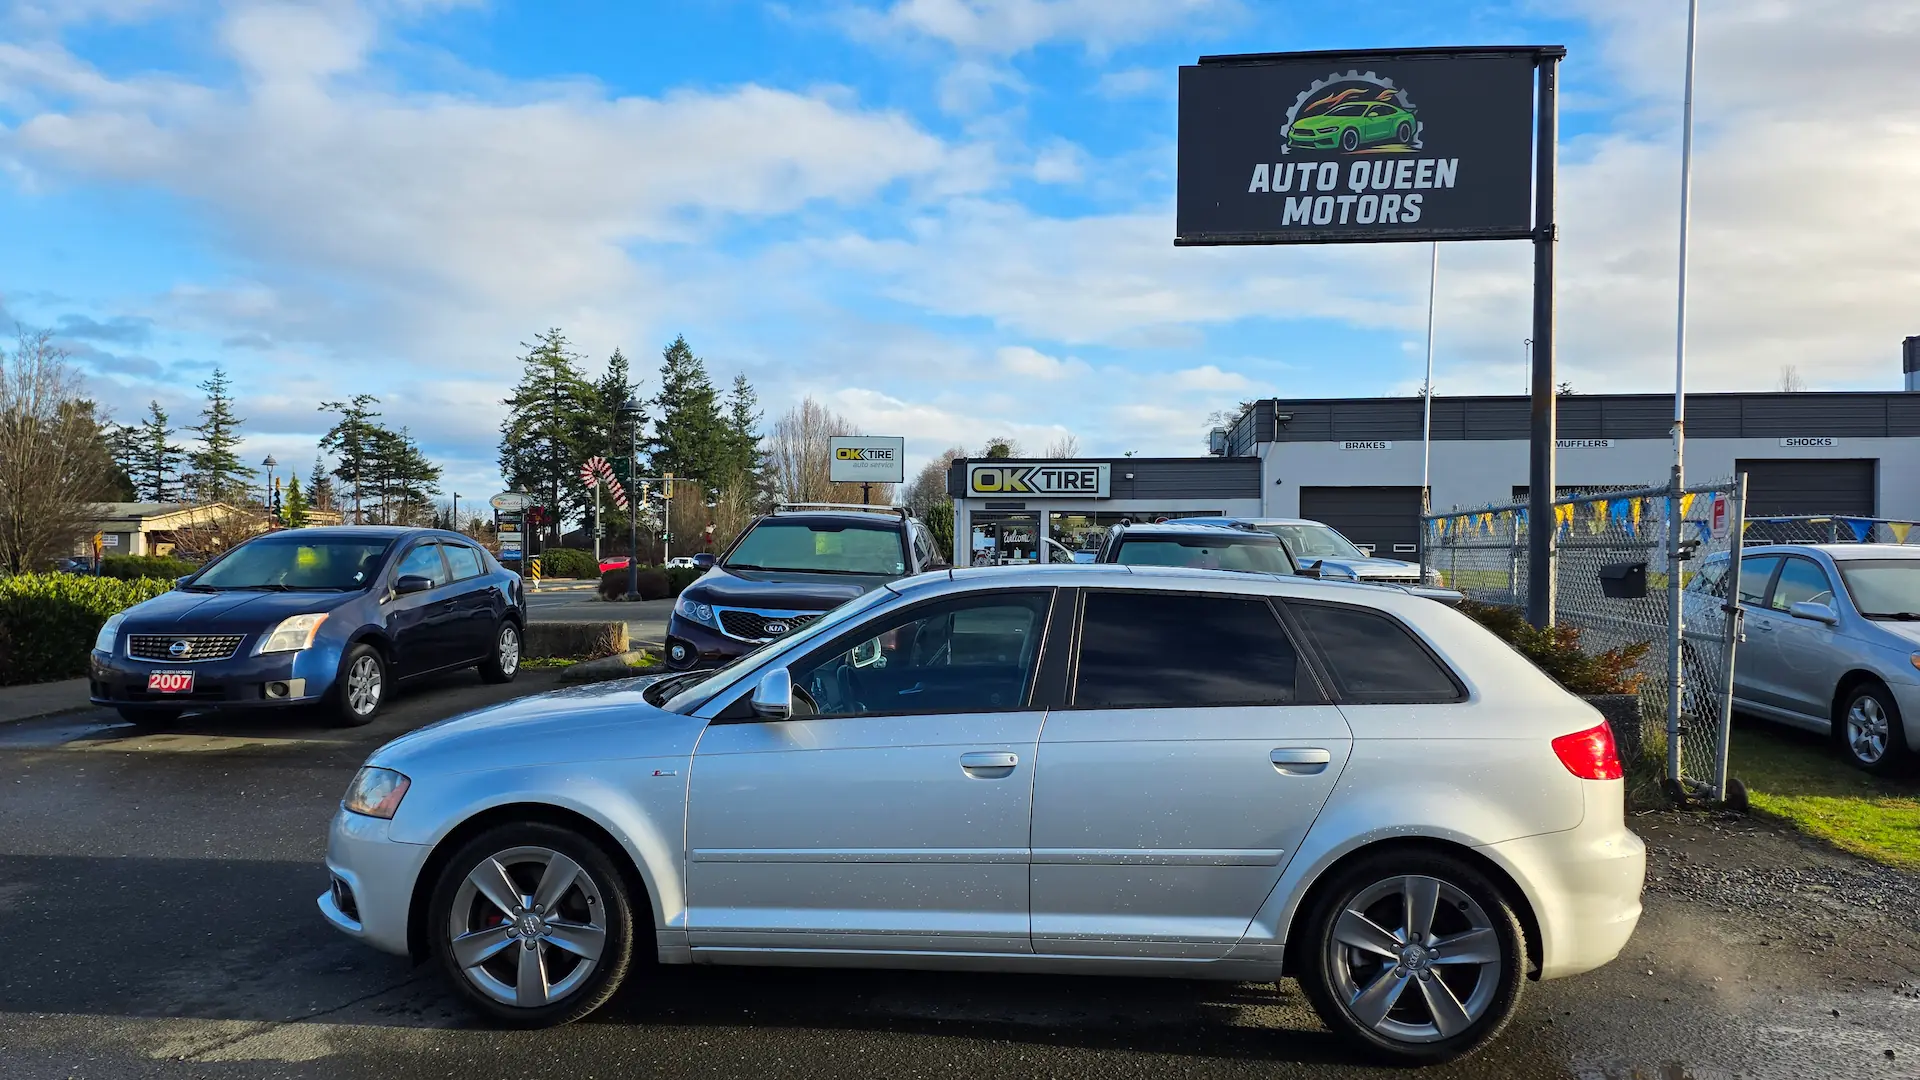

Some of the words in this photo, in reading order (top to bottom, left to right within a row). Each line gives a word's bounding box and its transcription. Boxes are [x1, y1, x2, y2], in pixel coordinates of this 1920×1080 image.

[1248, 162, 1339, 193] AUTO
[1348, 158, 1459, 193] QUEEN
[1282, 194, 1423, 225] MOTORS
[1555, 440, 1608, 448] MUFFLERS
[1786, 438, 1832, 446] SHOCKS
[837, 448, 862, 460] OK
[867, 450, 892, 459] TIRE
[870, 461, 894, 469] service
[973, 468, 1030, 492] OK
[1041, 471, 1095, 489] TIRE
[150, 674, 192, 689] 2007
